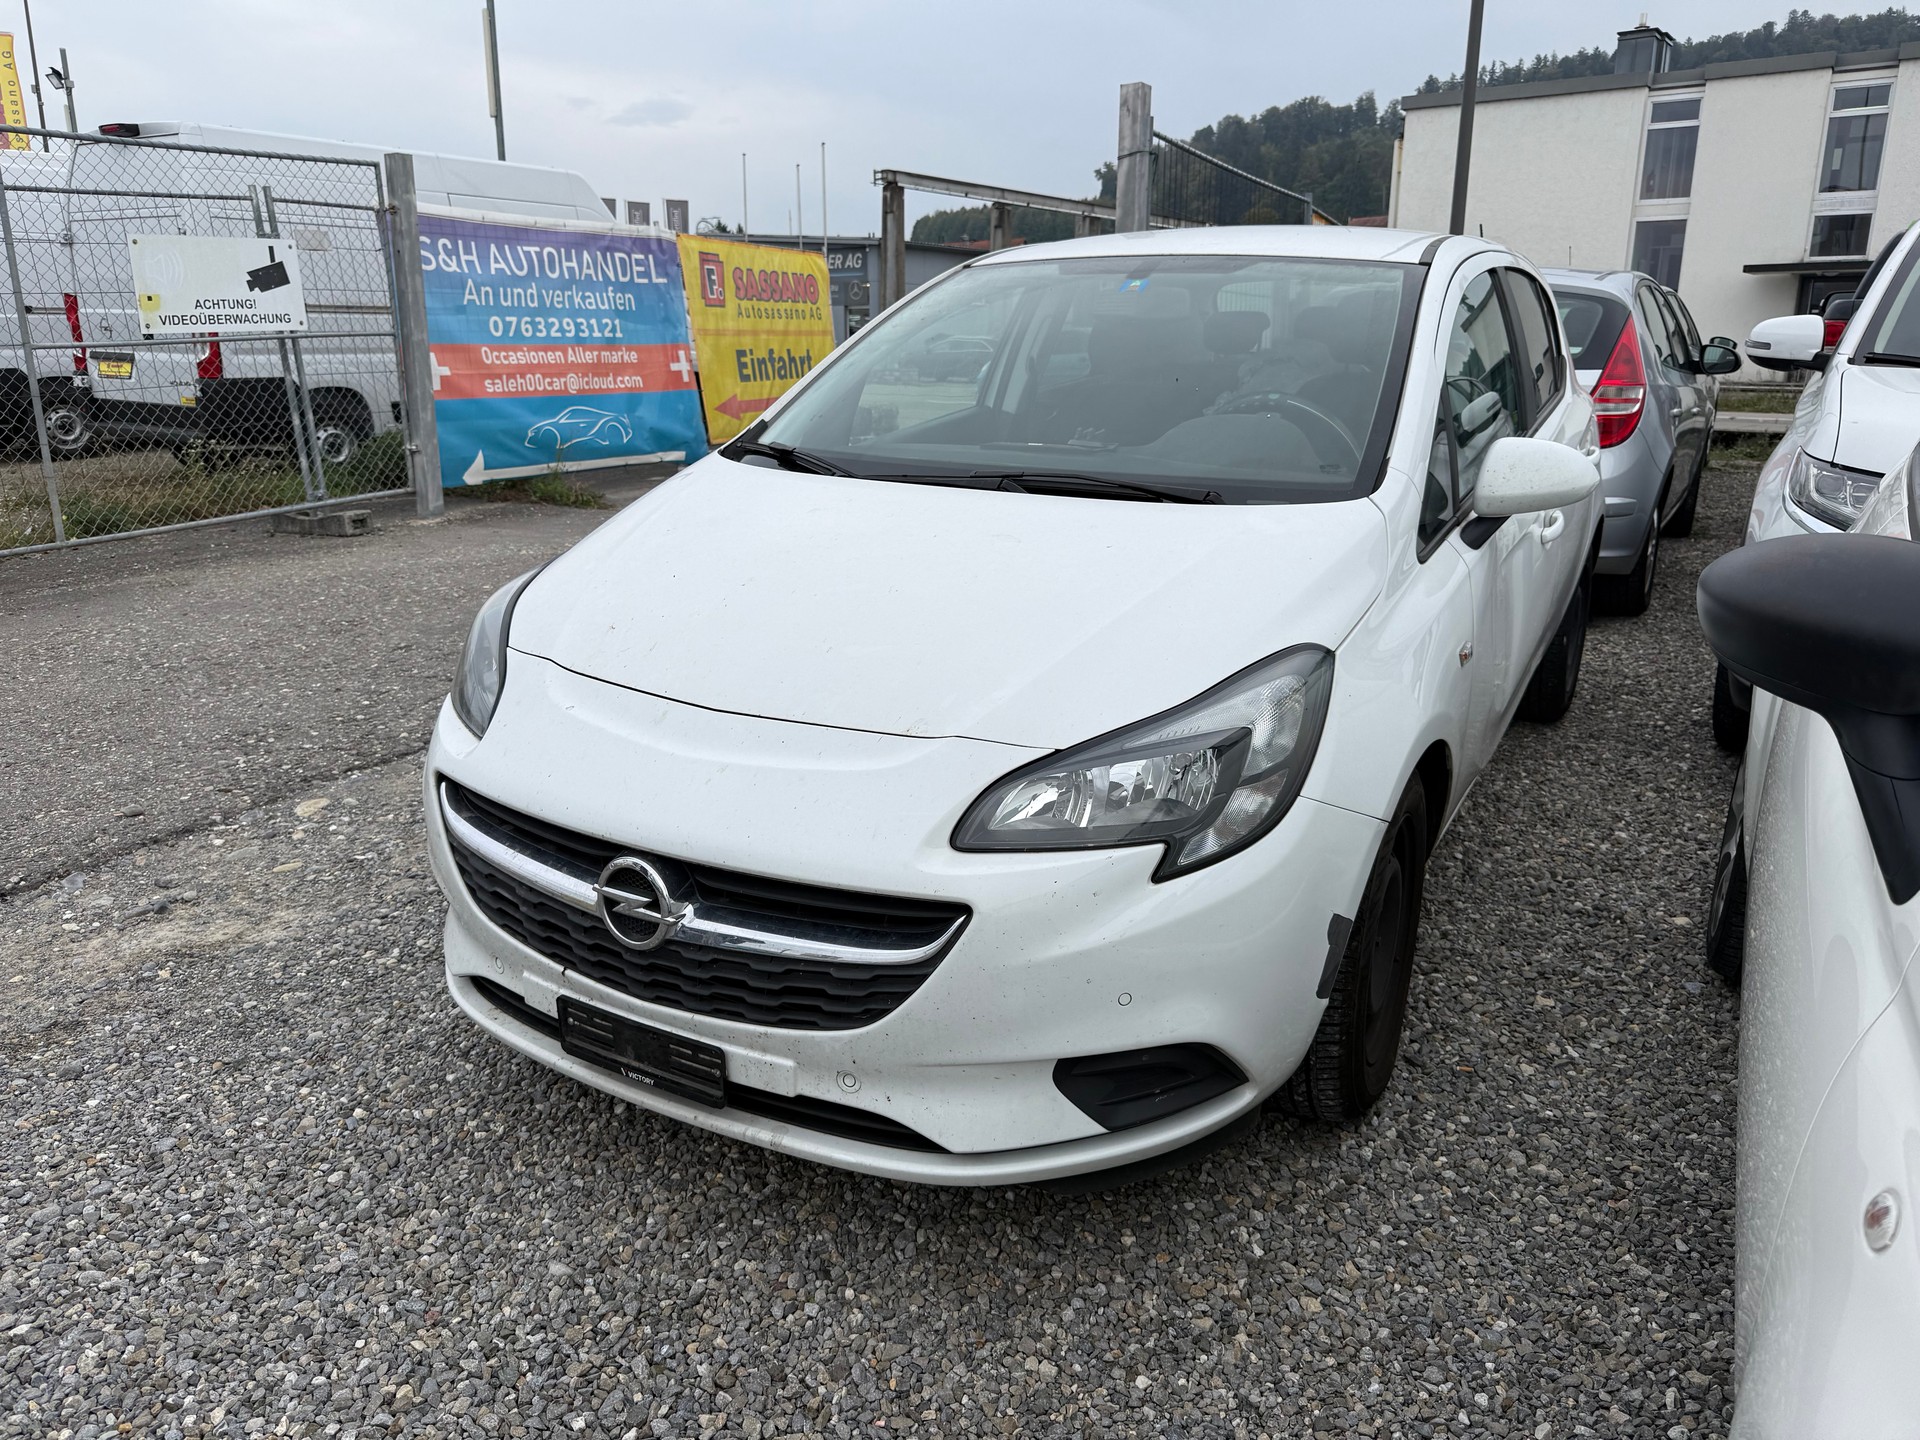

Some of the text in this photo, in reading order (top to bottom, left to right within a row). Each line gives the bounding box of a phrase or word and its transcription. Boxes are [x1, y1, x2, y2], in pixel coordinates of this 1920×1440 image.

[1, 50, 13, 70] AG
[419, 235, 668, 285] S&H AUTOHANDEL
[844, 253, 863, 269] AG
[463, 278, 636, 311] An und verkaufen
[732, 266, 820, 305] SASSANO
[194, 299, 257, 310] ACHTUNG!
[737, 304, 822, 320] Autosassano AG
[159, 313, 292, 326] VIDEOÜBERWACHUNG
[488, 315, 623, 338] 0763293121
[481, 346, 638, 364] Occasionen Aller marke
[735, 348, 812, 383] Einfahrt
[484, 373, 643, 394] saleh00car@icloud.com
[628, 1070, 655, 1086] VICTORY
